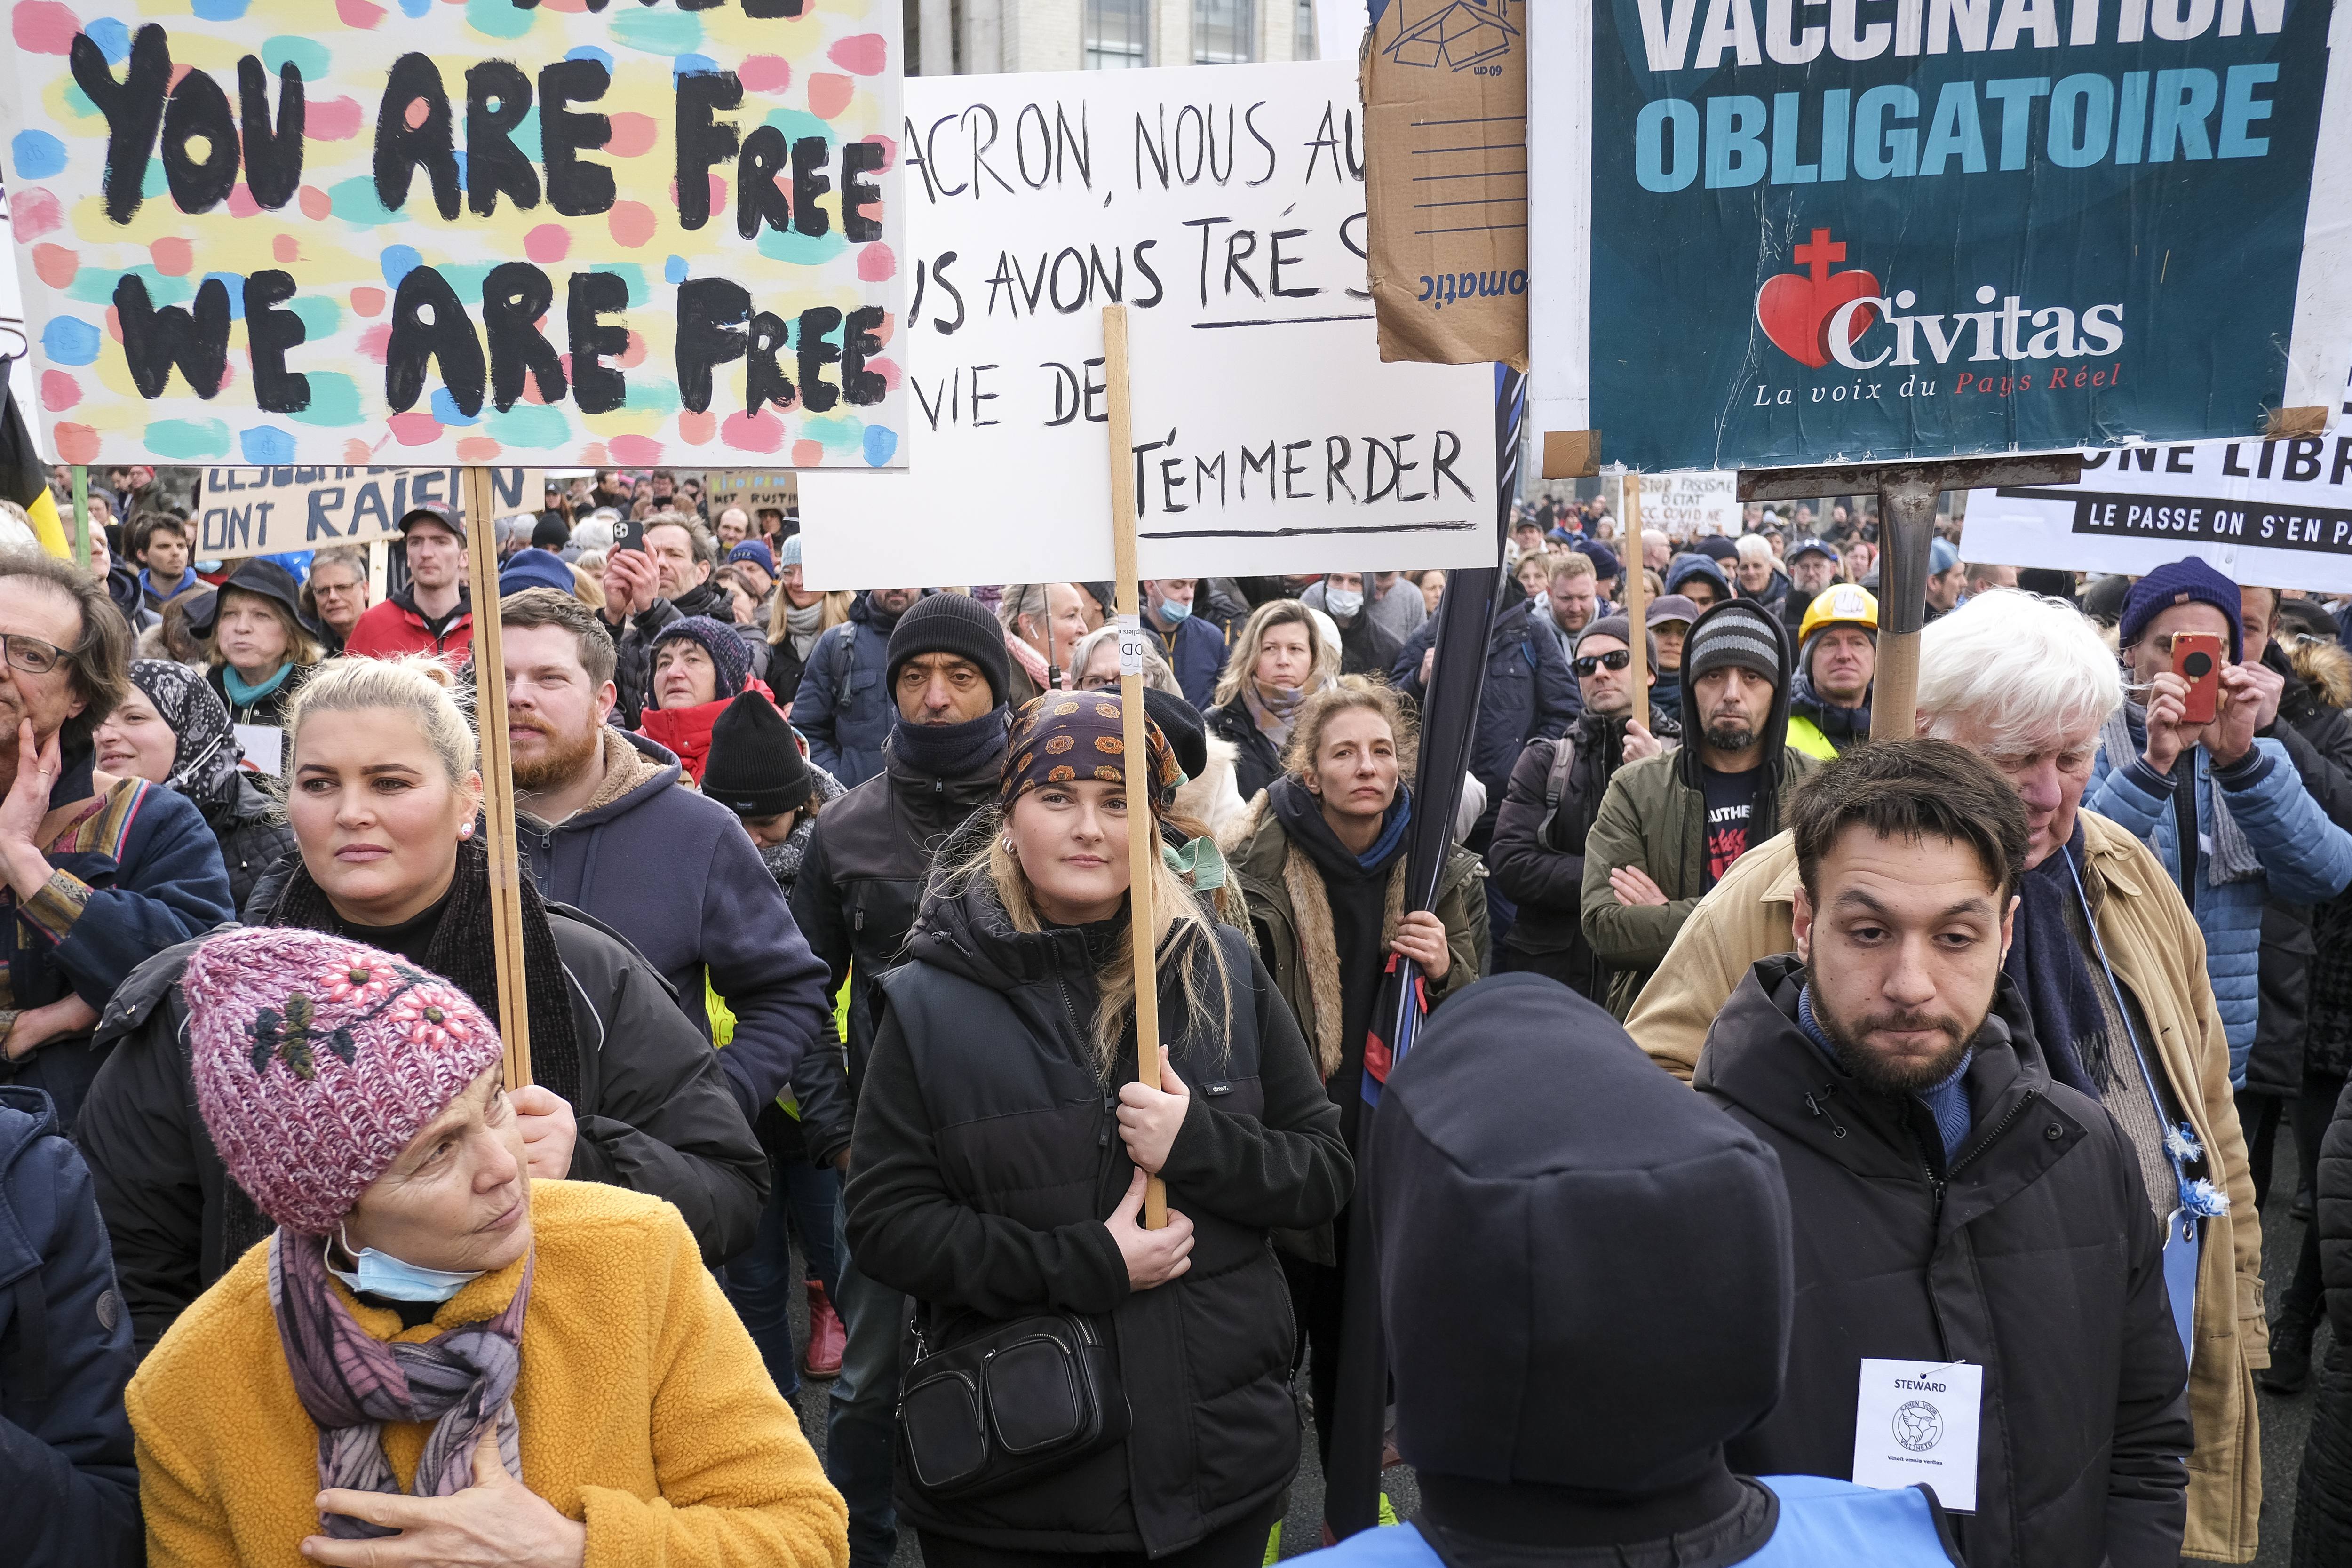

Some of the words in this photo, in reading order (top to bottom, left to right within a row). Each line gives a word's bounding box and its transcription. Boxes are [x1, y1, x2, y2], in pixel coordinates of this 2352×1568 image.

[1473, 66, 1488, 75] cm
[1489, 65, 1502, 76] 60
[70, 23, 305, 226] YOU
[373, 51, 617, 222] ARE
[675, 70, 887, 243] FREE
[1136, 101, 1276, 192] NOUS
[1635, 62, 2280, 193] OBLIGATOIRE
[984, 239, 1163, 320] AVONS
[1418, 269, 1527, 310] omatic
[112, 269, 311, 414] WE
[385, 262, 630, 418] ARE
[675, 276, 888, 419] FREE
[1828, 285, 2125, 370] Civitas
[910, 363, 1002, 431] VIE
[1038, 356, 1109, 427] DE
[1753, 384, 1793, 406] La
[1811, 378, 1883, 404] voix
[1899, 374, 1937, 398] du
[1954, 371, 2032, 397] Pays
[2048, 362, 2122, 390] Réel
[203, 501, 275, 550] ONT
[2089, 503, 2117, 527] LE
[2126, 505, 2202, 533] PASSE
[2212, 510, 2245, 536] ON
[2333, 520, 2352, 546] P
[1894, 1379, 1947, 1393] STEWARD
[1900, 1401, 1920, 1412] SAMEN
[1923, 1402, 1938, 1416] VOOR
